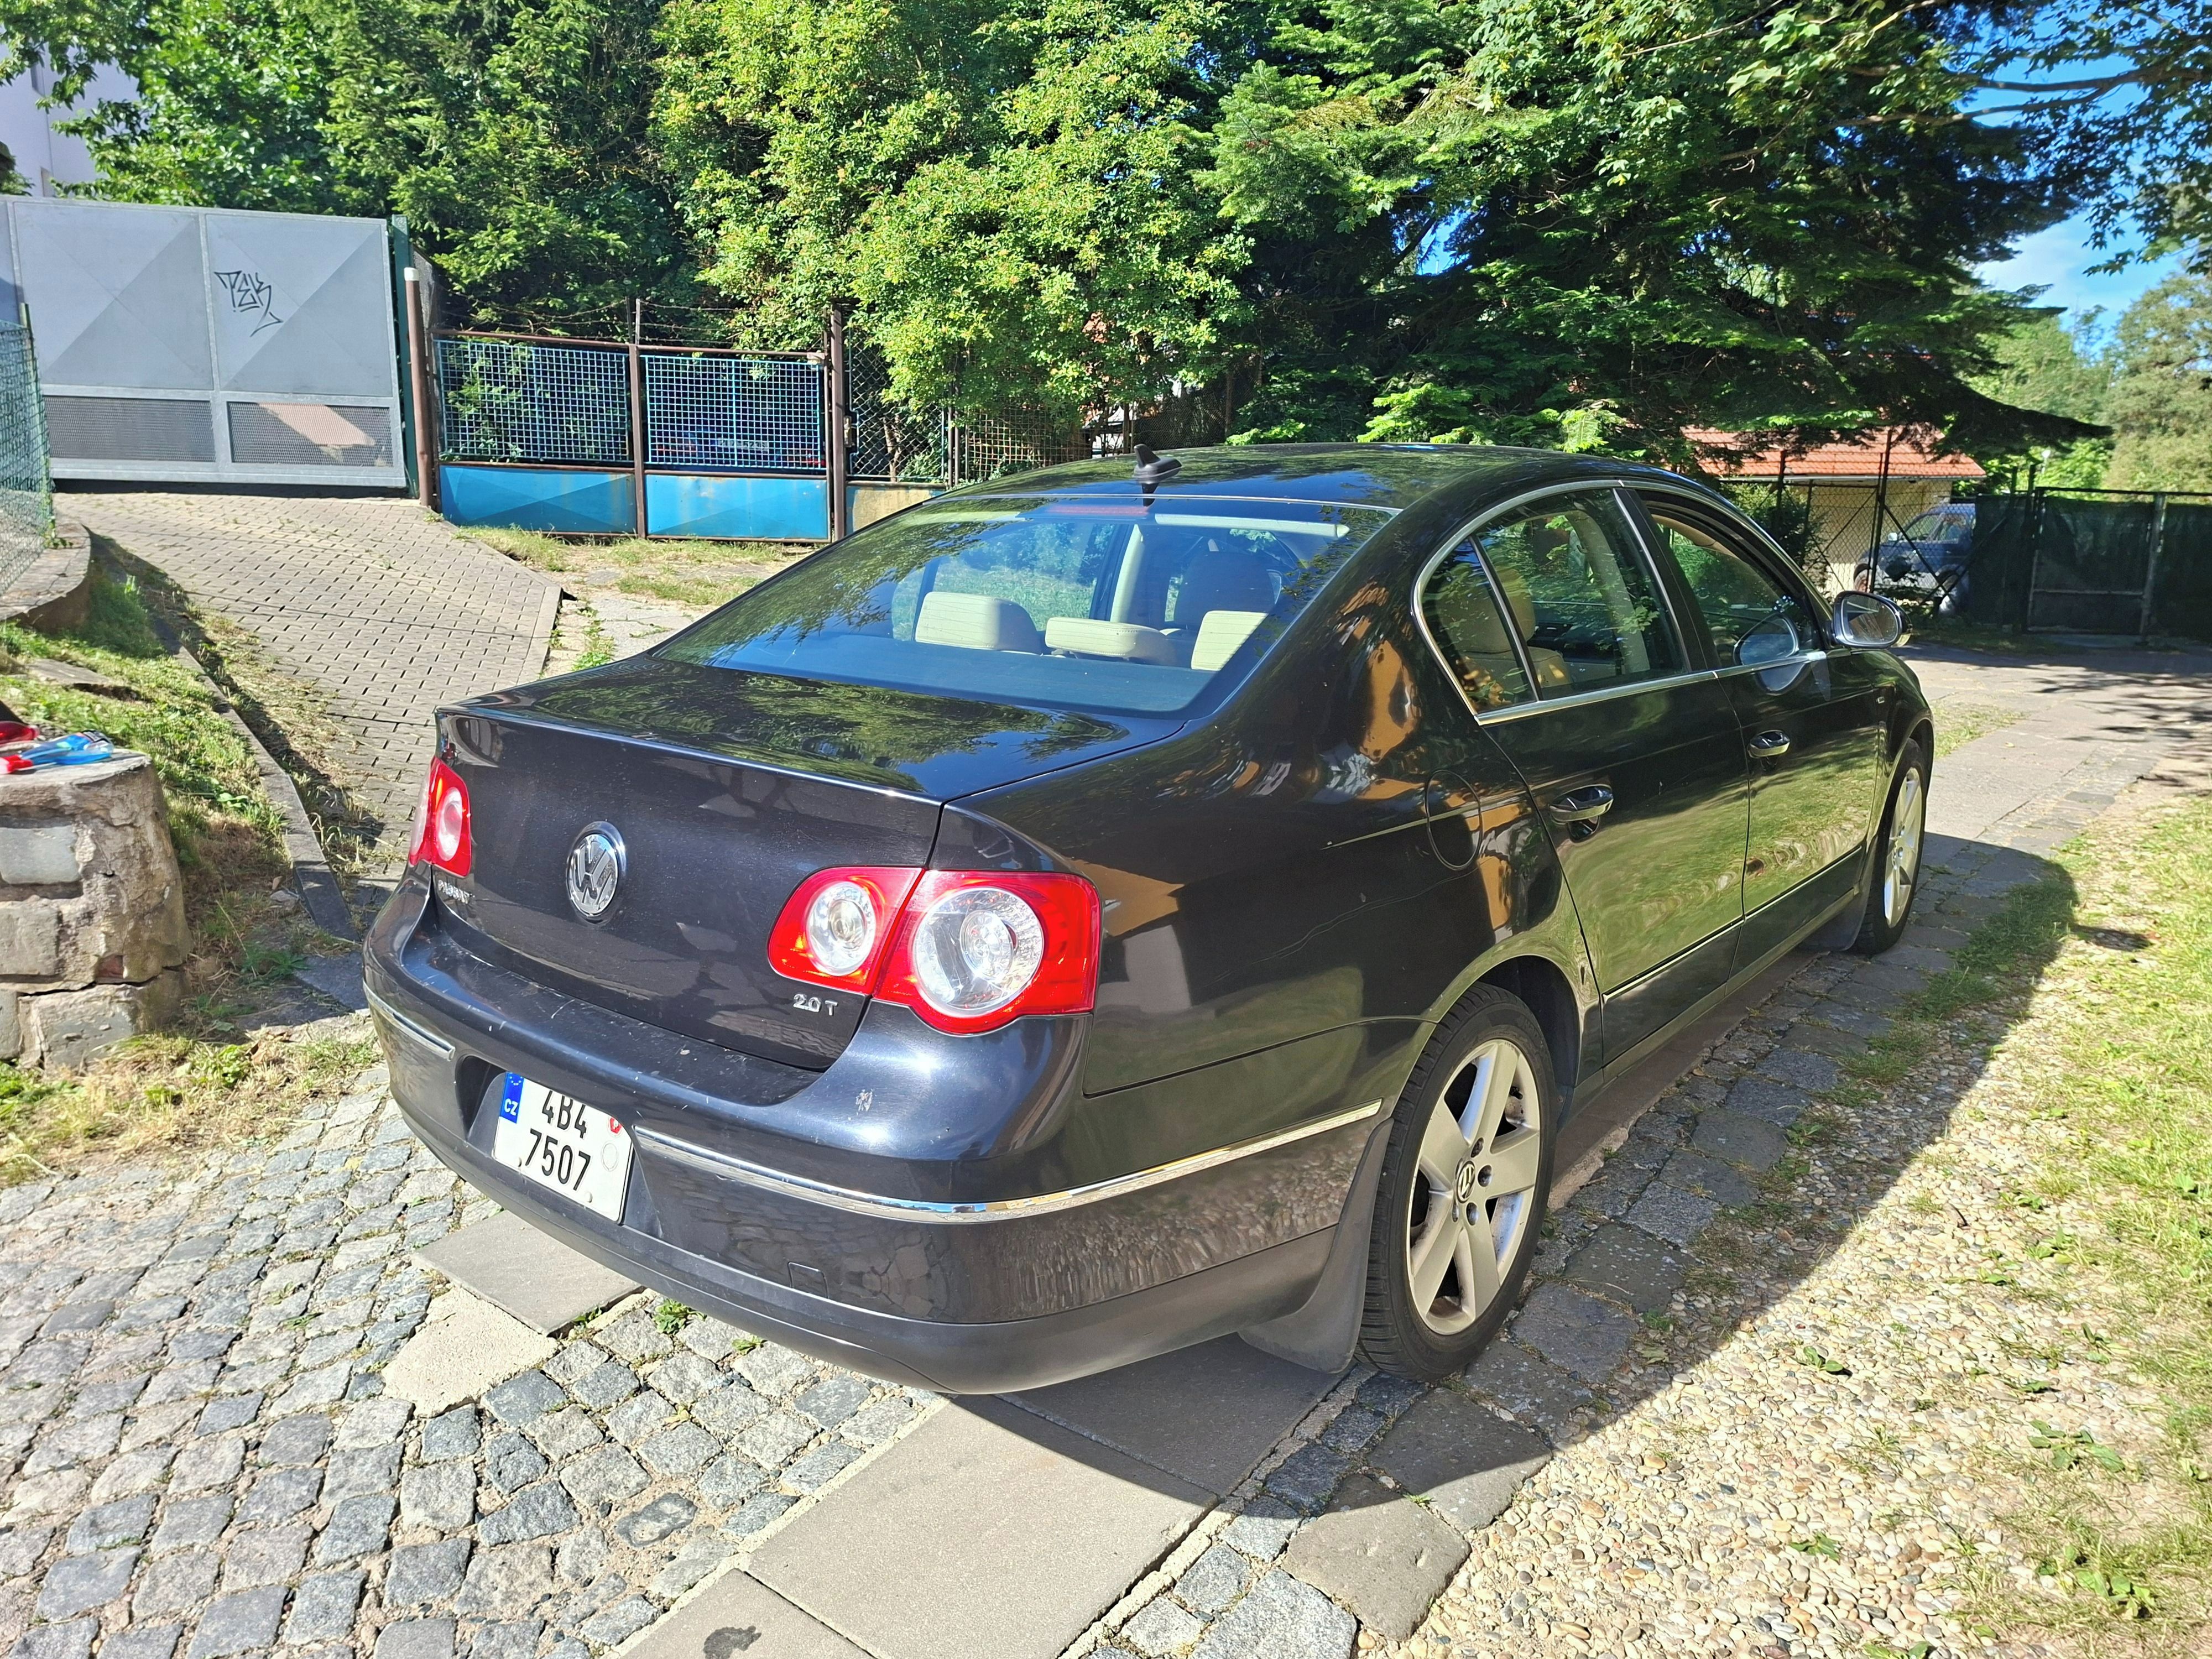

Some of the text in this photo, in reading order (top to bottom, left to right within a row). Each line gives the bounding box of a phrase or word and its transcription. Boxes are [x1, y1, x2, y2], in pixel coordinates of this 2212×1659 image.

[825, 1000, 839, 1016] T
[504, 1098, 519, 1116] CZ
[542, 1091, 587, 1139] 4B4
[525, 1128, 591, 1191] 7507
